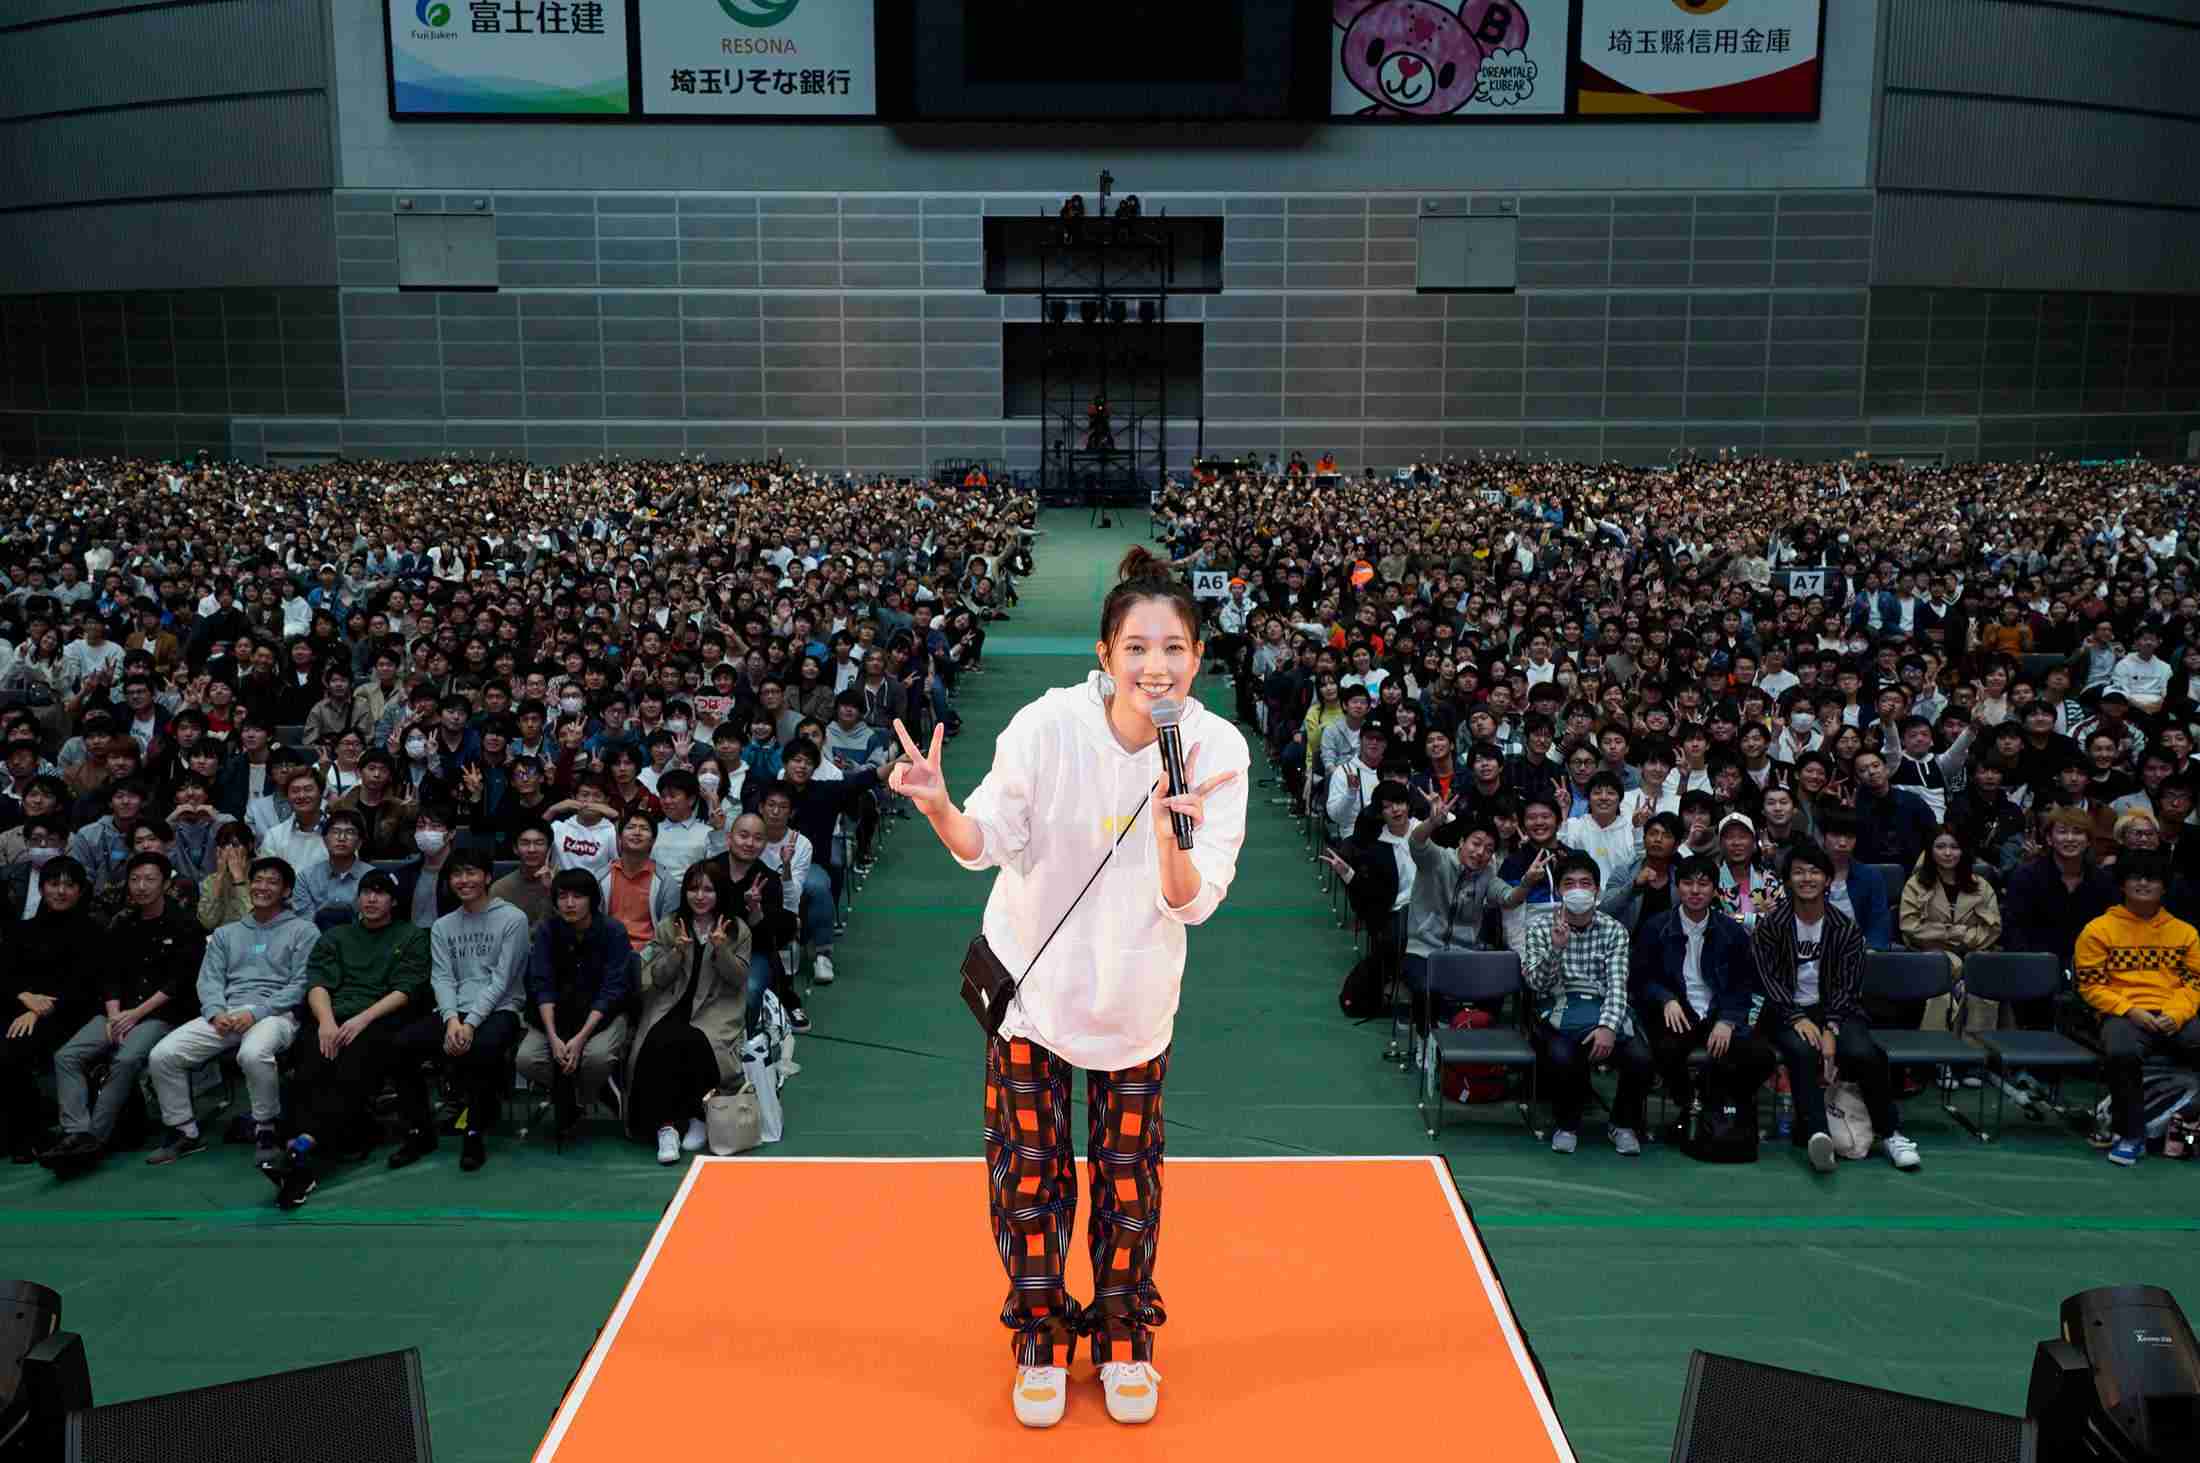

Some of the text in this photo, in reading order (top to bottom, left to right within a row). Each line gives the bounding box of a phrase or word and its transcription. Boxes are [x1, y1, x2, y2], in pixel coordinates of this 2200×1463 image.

[469, 0, 606, 35] 富士住建
[721, 37, 797, 55] RESONA
[1607, 27, 1792, 56] 埼玉縣信用金庫
[670, 68, 851, 95] 埼玉りそな銀行
[1197, 575, 1224, 591] A6
[1793, 575, 1821, 590] A7
